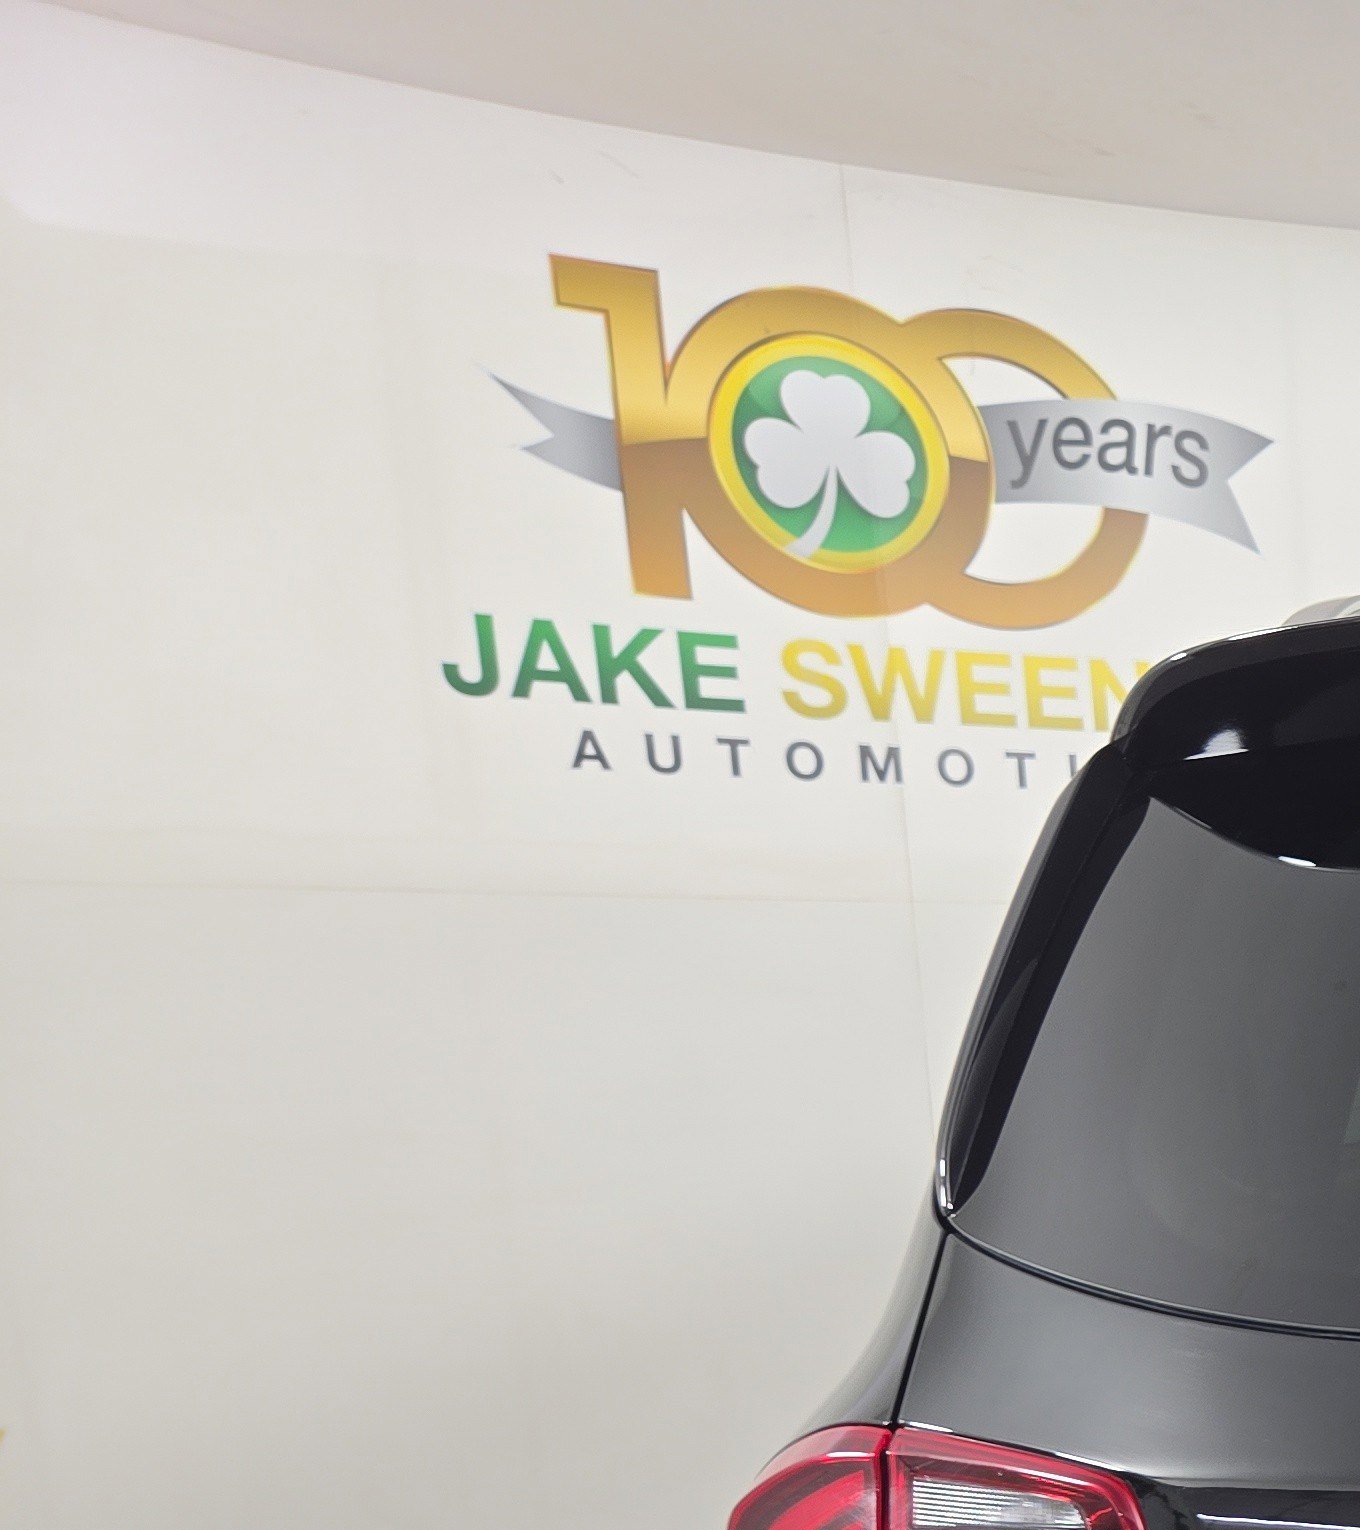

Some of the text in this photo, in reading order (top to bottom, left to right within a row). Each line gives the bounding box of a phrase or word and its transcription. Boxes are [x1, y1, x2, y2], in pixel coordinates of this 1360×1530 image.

[549, 254, 1149, 631] 100
[1005, 415, 1211, 490] years
[442, 613, 1150, 734] JAKE SWEEN
[572, 730, 1080, 790] AUTOMOTI
